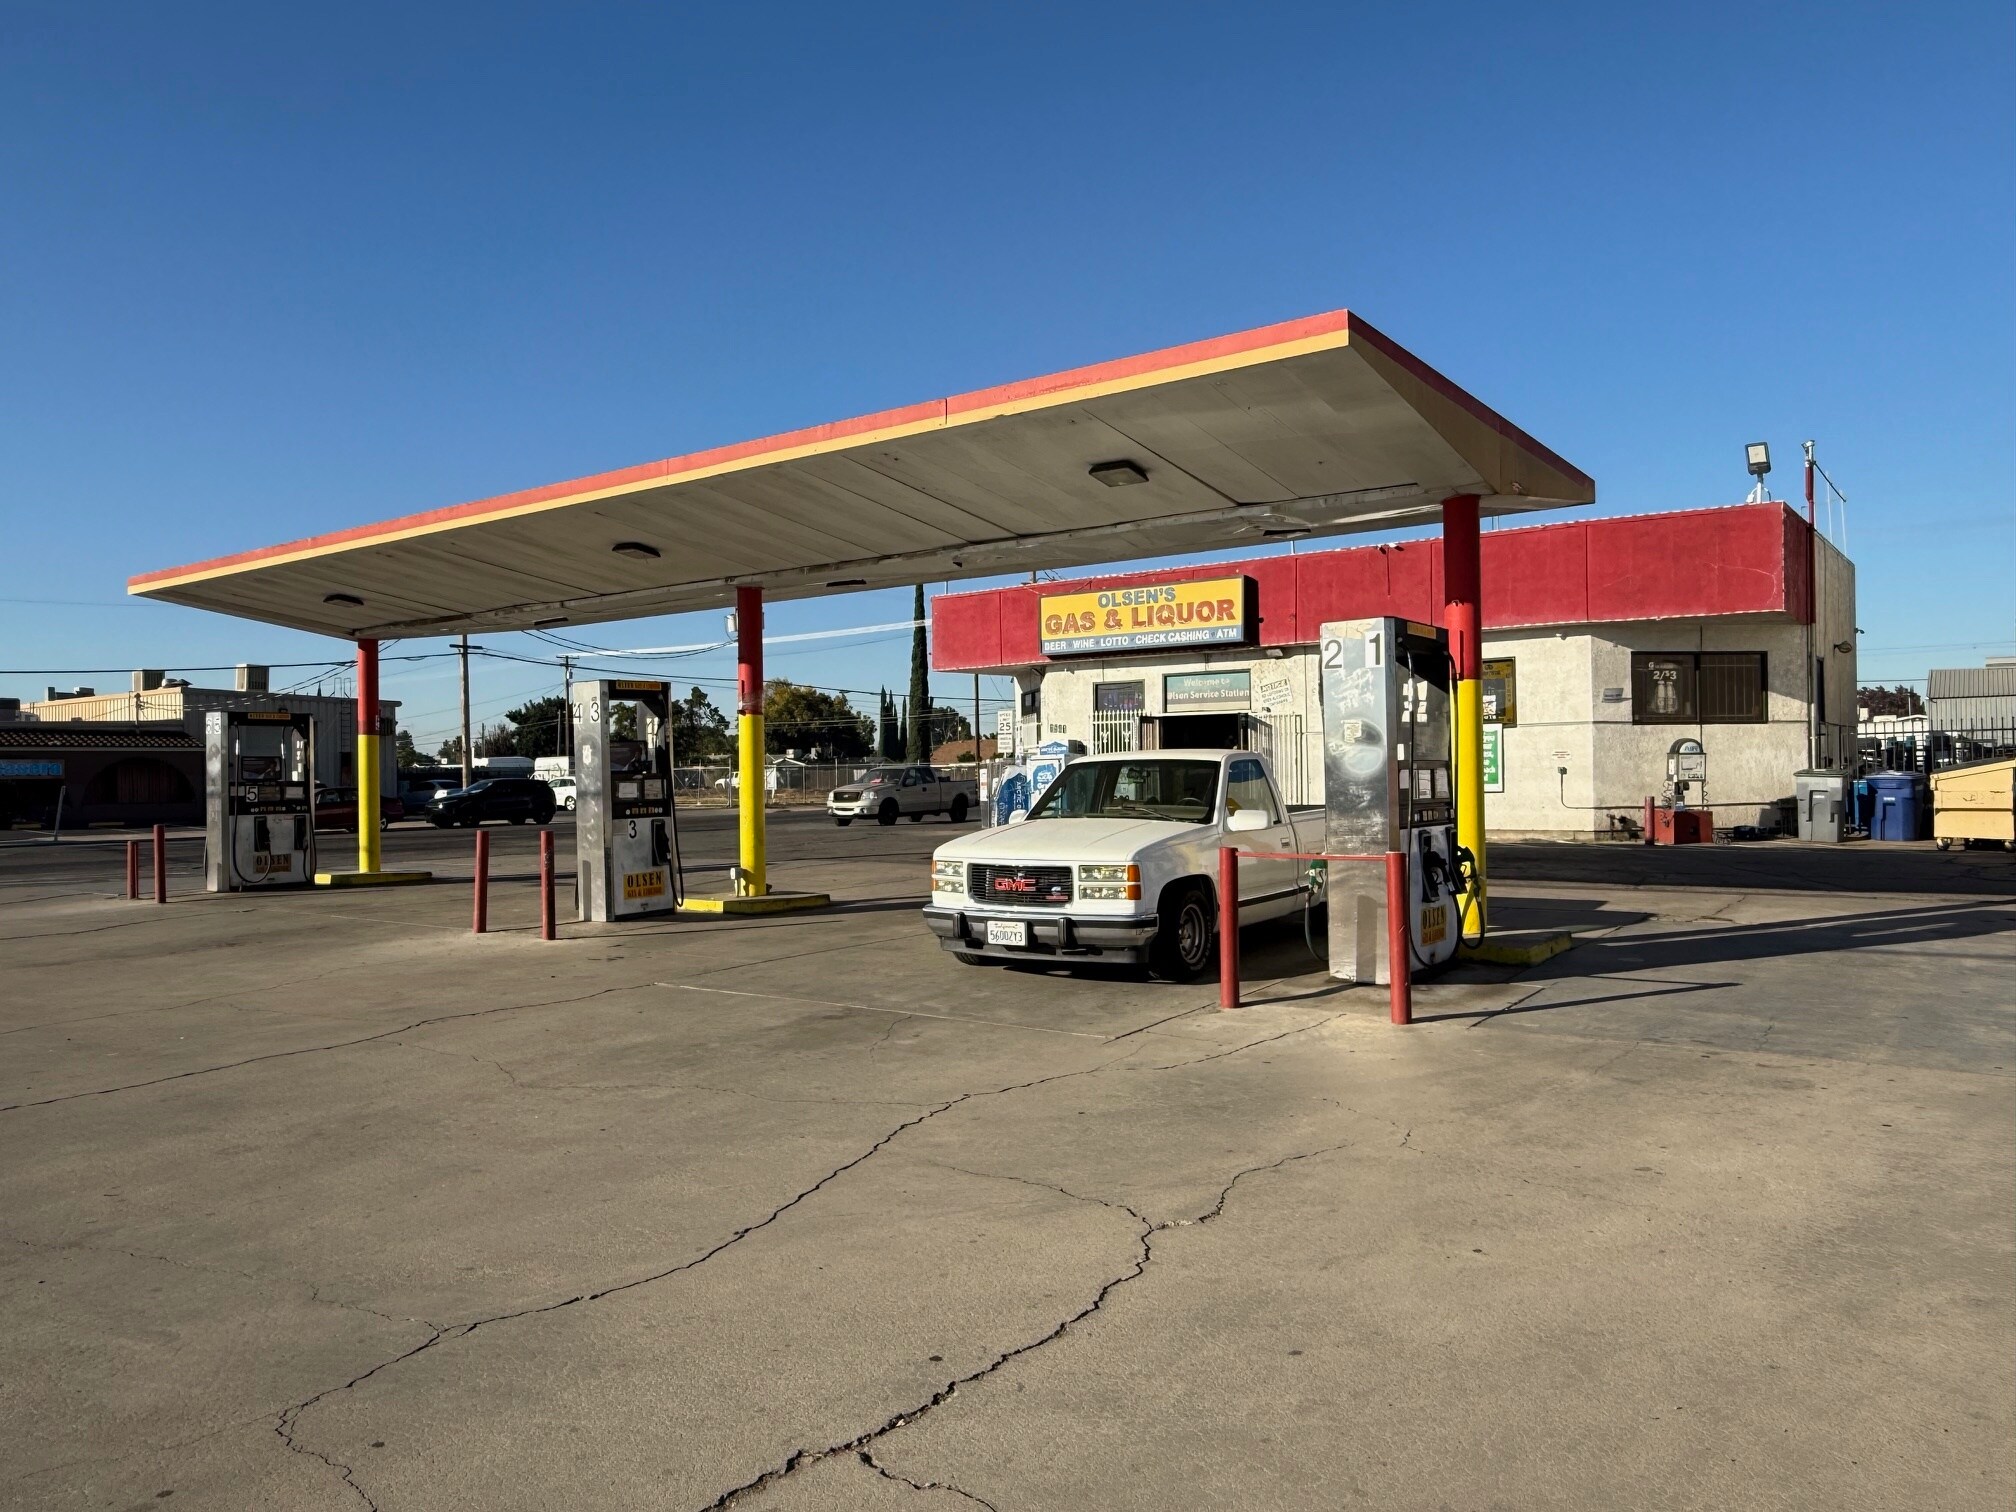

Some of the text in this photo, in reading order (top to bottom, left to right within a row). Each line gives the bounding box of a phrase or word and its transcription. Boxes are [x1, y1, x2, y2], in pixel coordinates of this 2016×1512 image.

[1098, 586, 1176, 608] OLSEN'S
[1045, 599, 1237, 635] GAS & LIQUOR
[1073, 639, 1095, 649] WINE
[1100, 636, 1129, 647] LOTTO
[1135, 633, 1167, 644] CHECK
[1168, 630, 1210, 641] CASHING
[1216, 628, 1237, 638] ATM
[1324, 639, 1343, 670] 2
[1368, 632, 1381, 666] 1
[1190, 690, 1219, 699] Service
[1220, 689, 1250, 698] Station
[573, 702, 583, 723] 4
[590, 702, 600, 722] 3
[999, 722, 1012, 732] 25
[247, 786, 257, 801] 5
[628, 820, 638, 839] 3
[627, 871, 662, 888] OLSEN
[994, 877, 1037, 892] GMC
